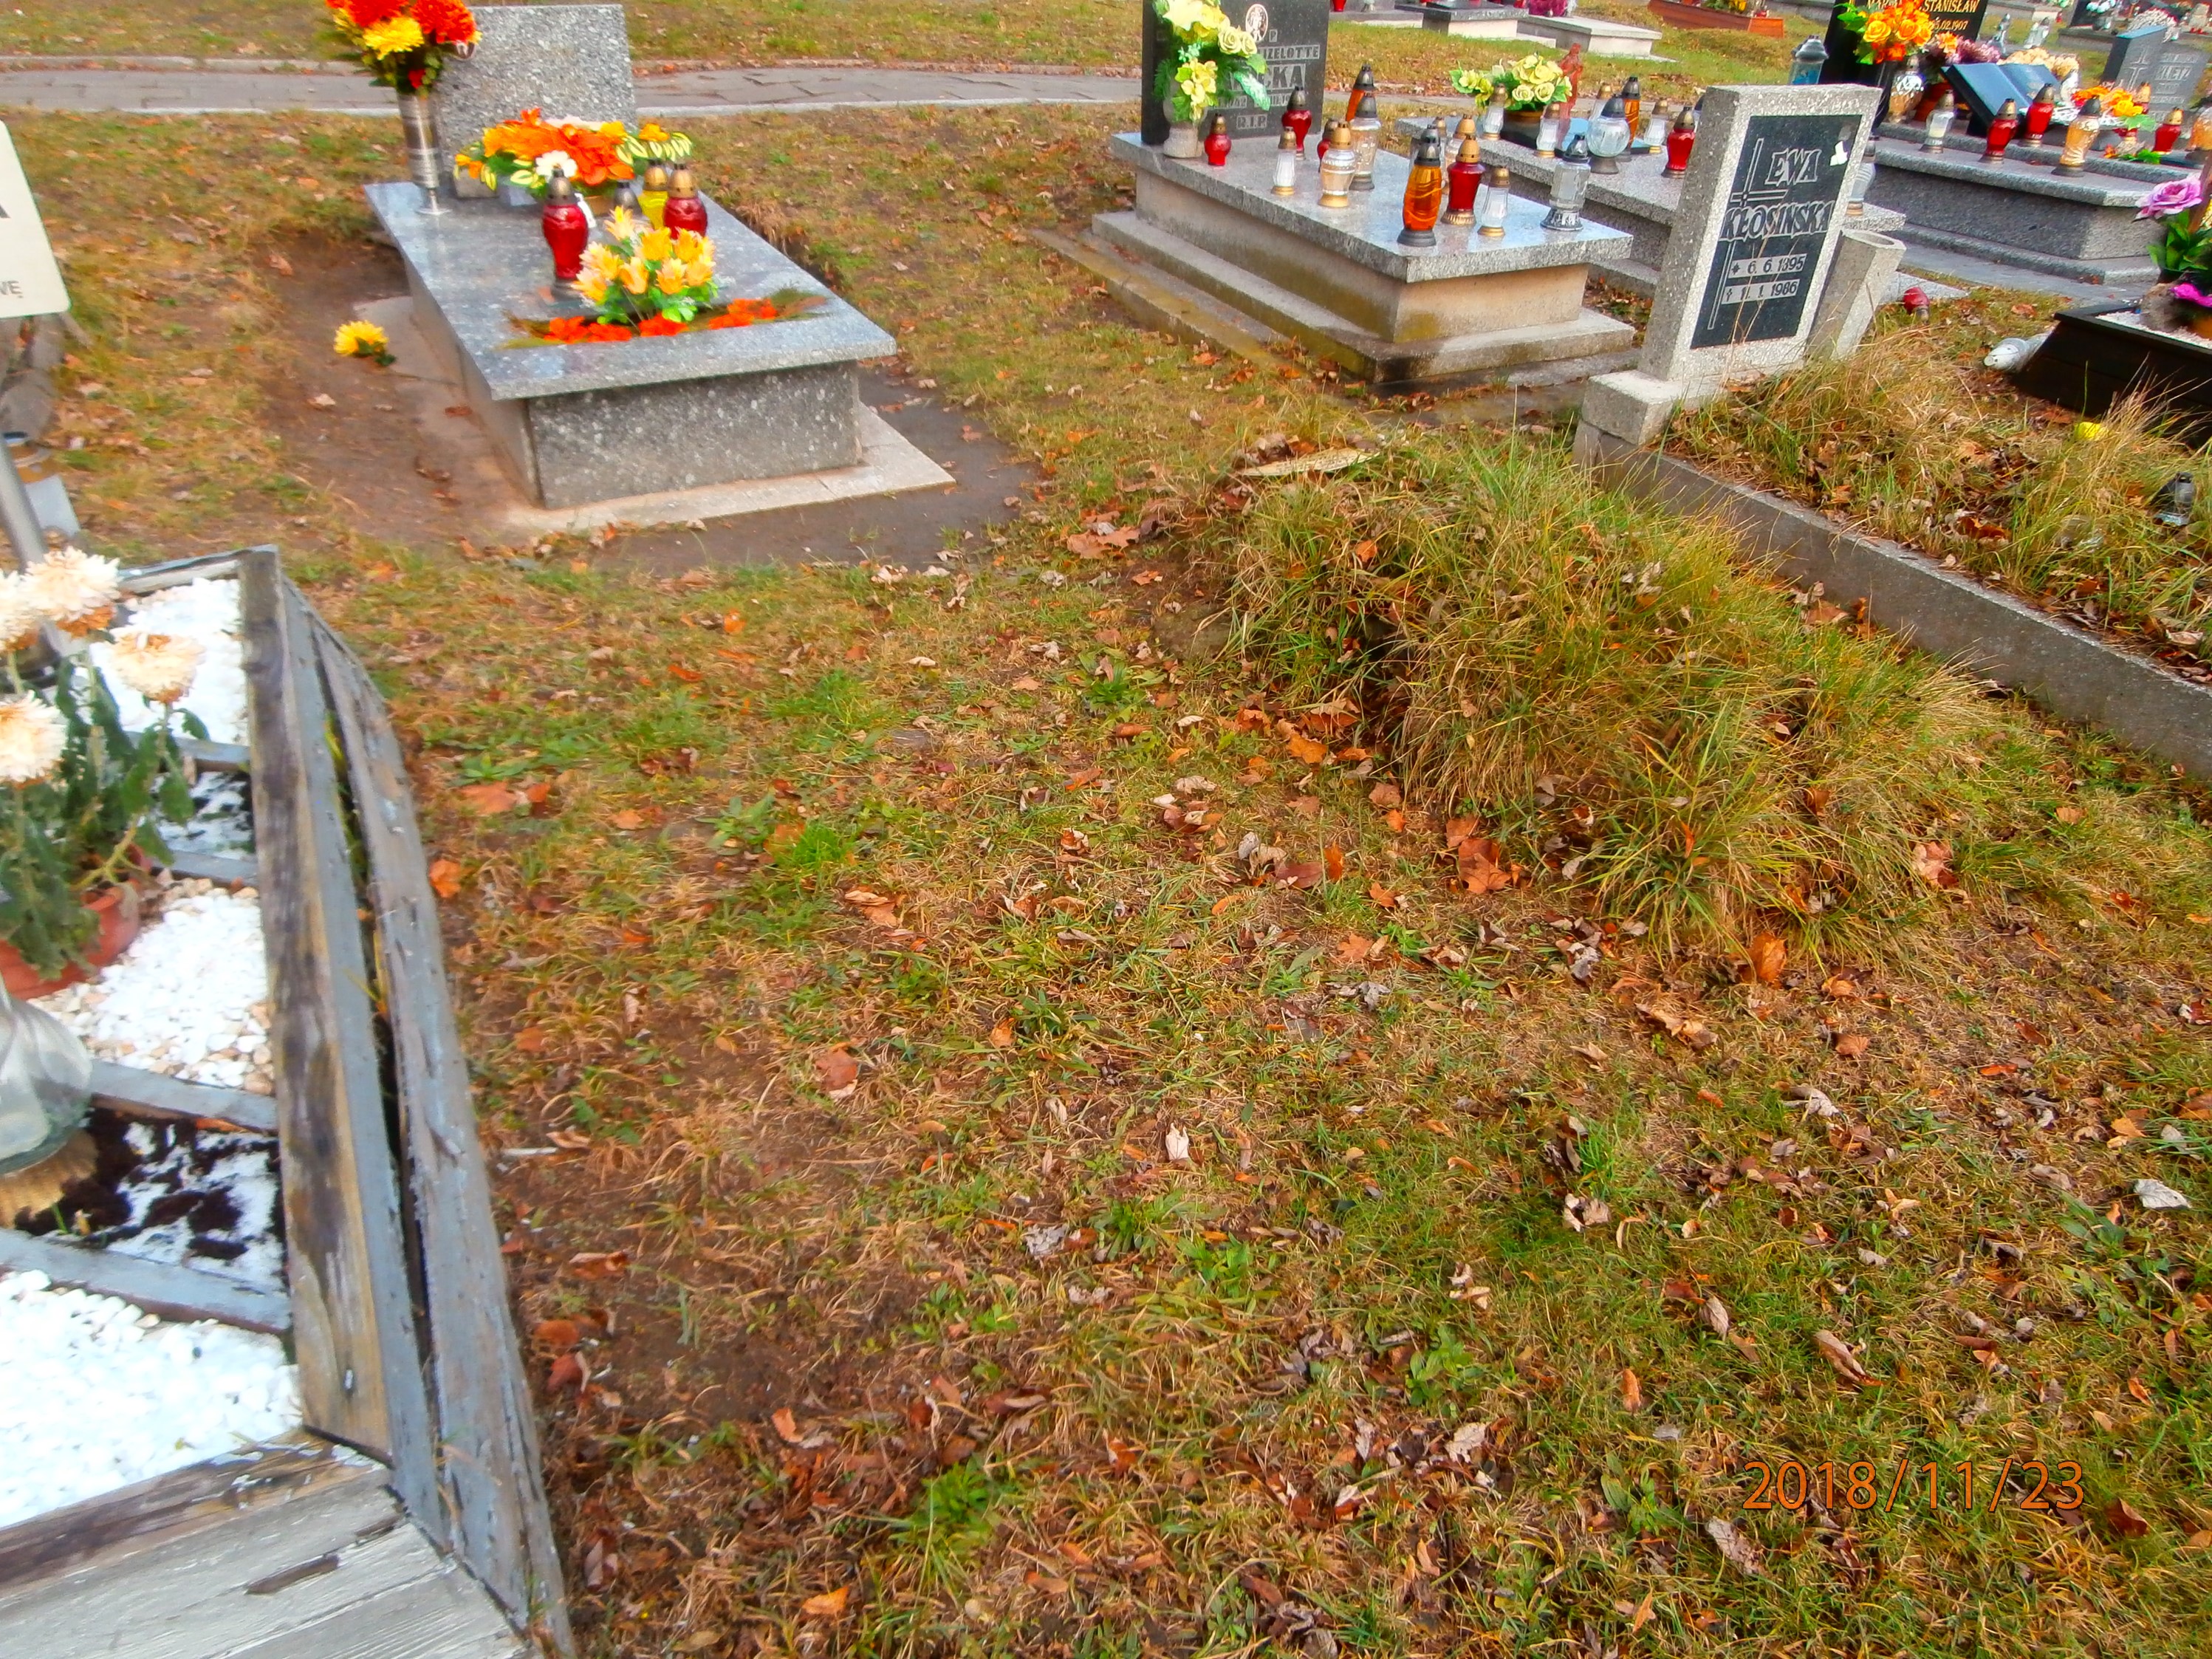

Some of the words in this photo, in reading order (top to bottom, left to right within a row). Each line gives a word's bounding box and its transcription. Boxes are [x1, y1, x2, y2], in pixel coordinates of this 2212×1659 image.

[1764, 148, 1822, 186] EWA
[1763, 259, 1773, 273] 6.
[1771, 281, 1798, 297] 1986
